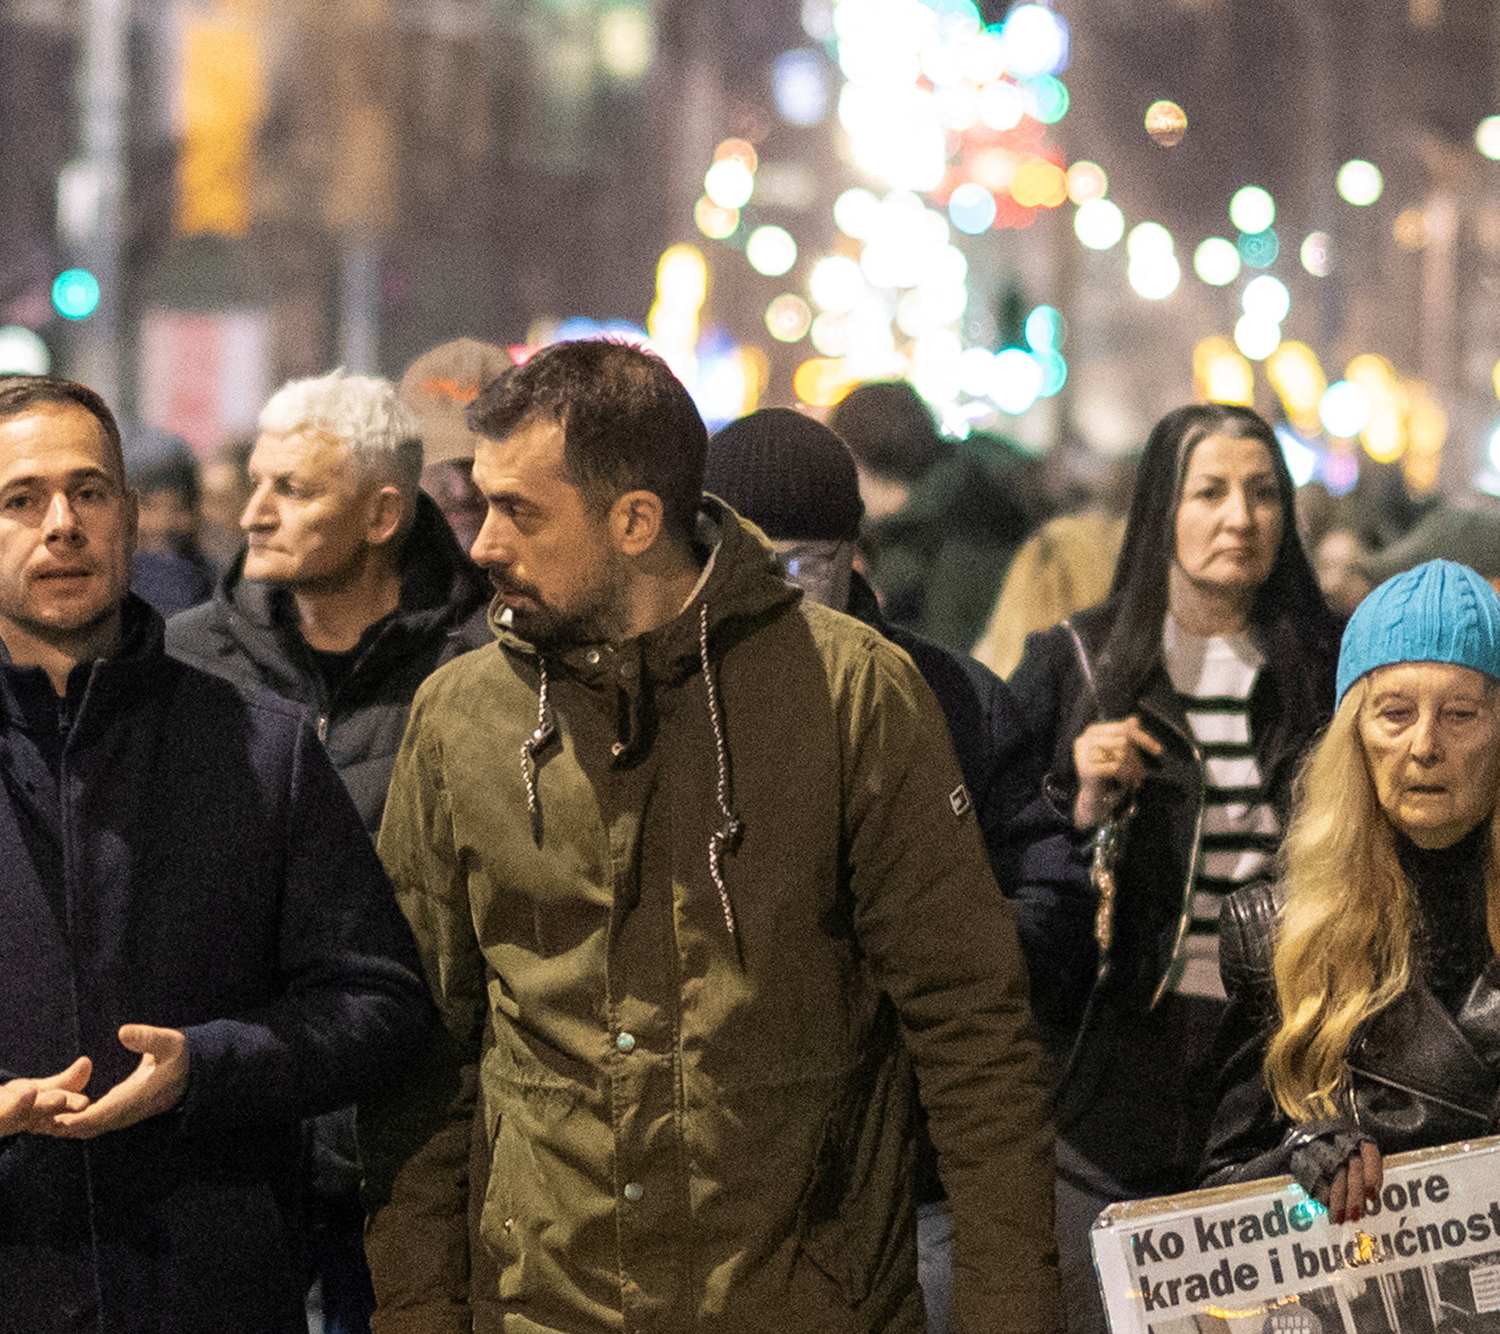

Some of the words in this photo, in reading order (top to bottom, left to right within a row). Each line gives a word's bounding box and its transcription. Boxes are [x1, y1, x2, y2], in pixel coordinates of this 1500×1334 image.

[1130, 1228, 1185, 1267] Ko
[1193, 1198, 1314, 1253] krade
[1139, 1257, 1260, 1312] krade
[1268, 1248, 1285, 1285] i
